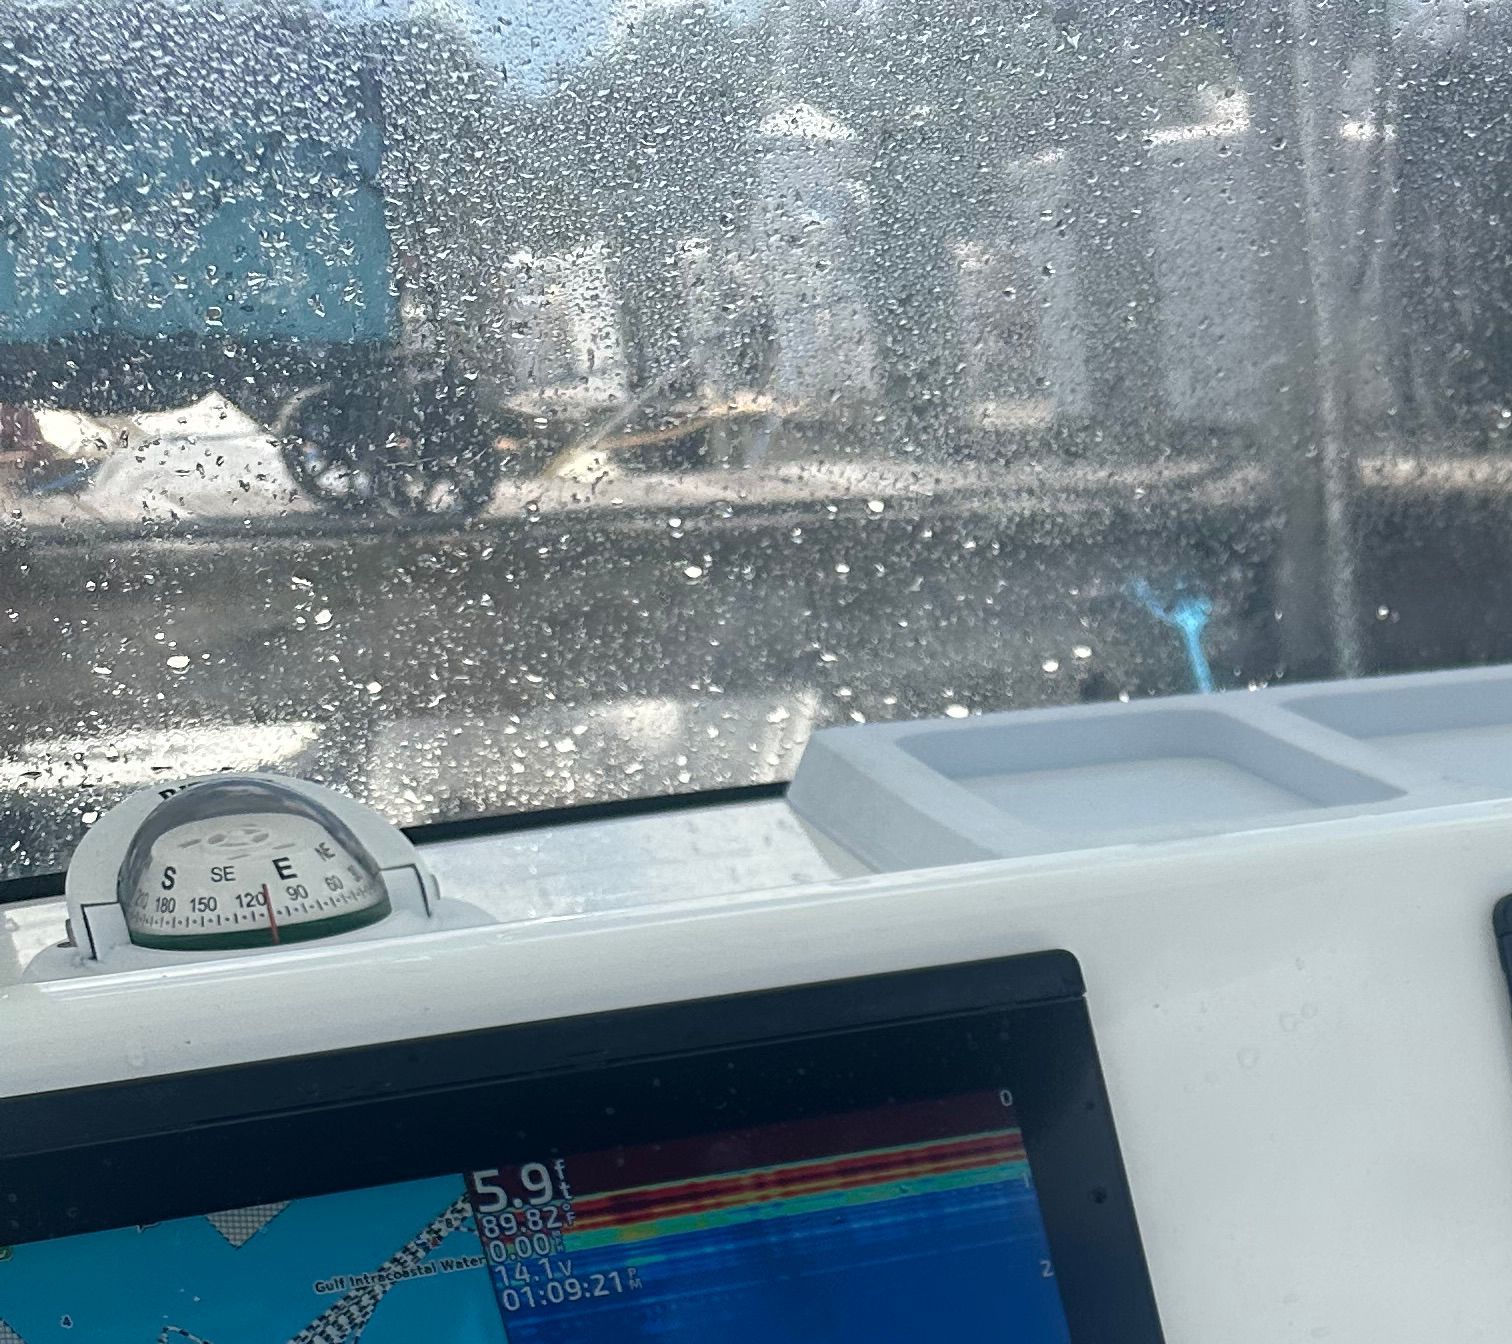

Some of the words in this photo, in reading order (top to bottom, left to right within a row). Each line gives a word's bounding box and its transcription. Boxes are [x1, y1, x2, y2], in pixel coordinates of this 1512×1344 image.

[161, 866, 177, 891] S
[210, 865, 237, 882] SE
[272, 856, 298, 881] E
[155, 896, 177, 914] 180
[190, 896, 217, 914] 150
[235, 890, 267, 909] 120
[285, 883, 309, 903] 90
[1000, 1089, 1013, 1107] 0
[473, 1162, 555, 1213] 5.9
[481, 1205, 563, 1239] 89.82
[490, 1232, 551, 1263] 0.00
[314, 1278, 346, 1294] Gulf
[350, 1263, 437, 1288] Intracoastal
[495, 1257, 553, 1287] 14.1
[1040, 1260, 1054, 1277] 2
[502, 1270, 624, 1312] 01:09:21
